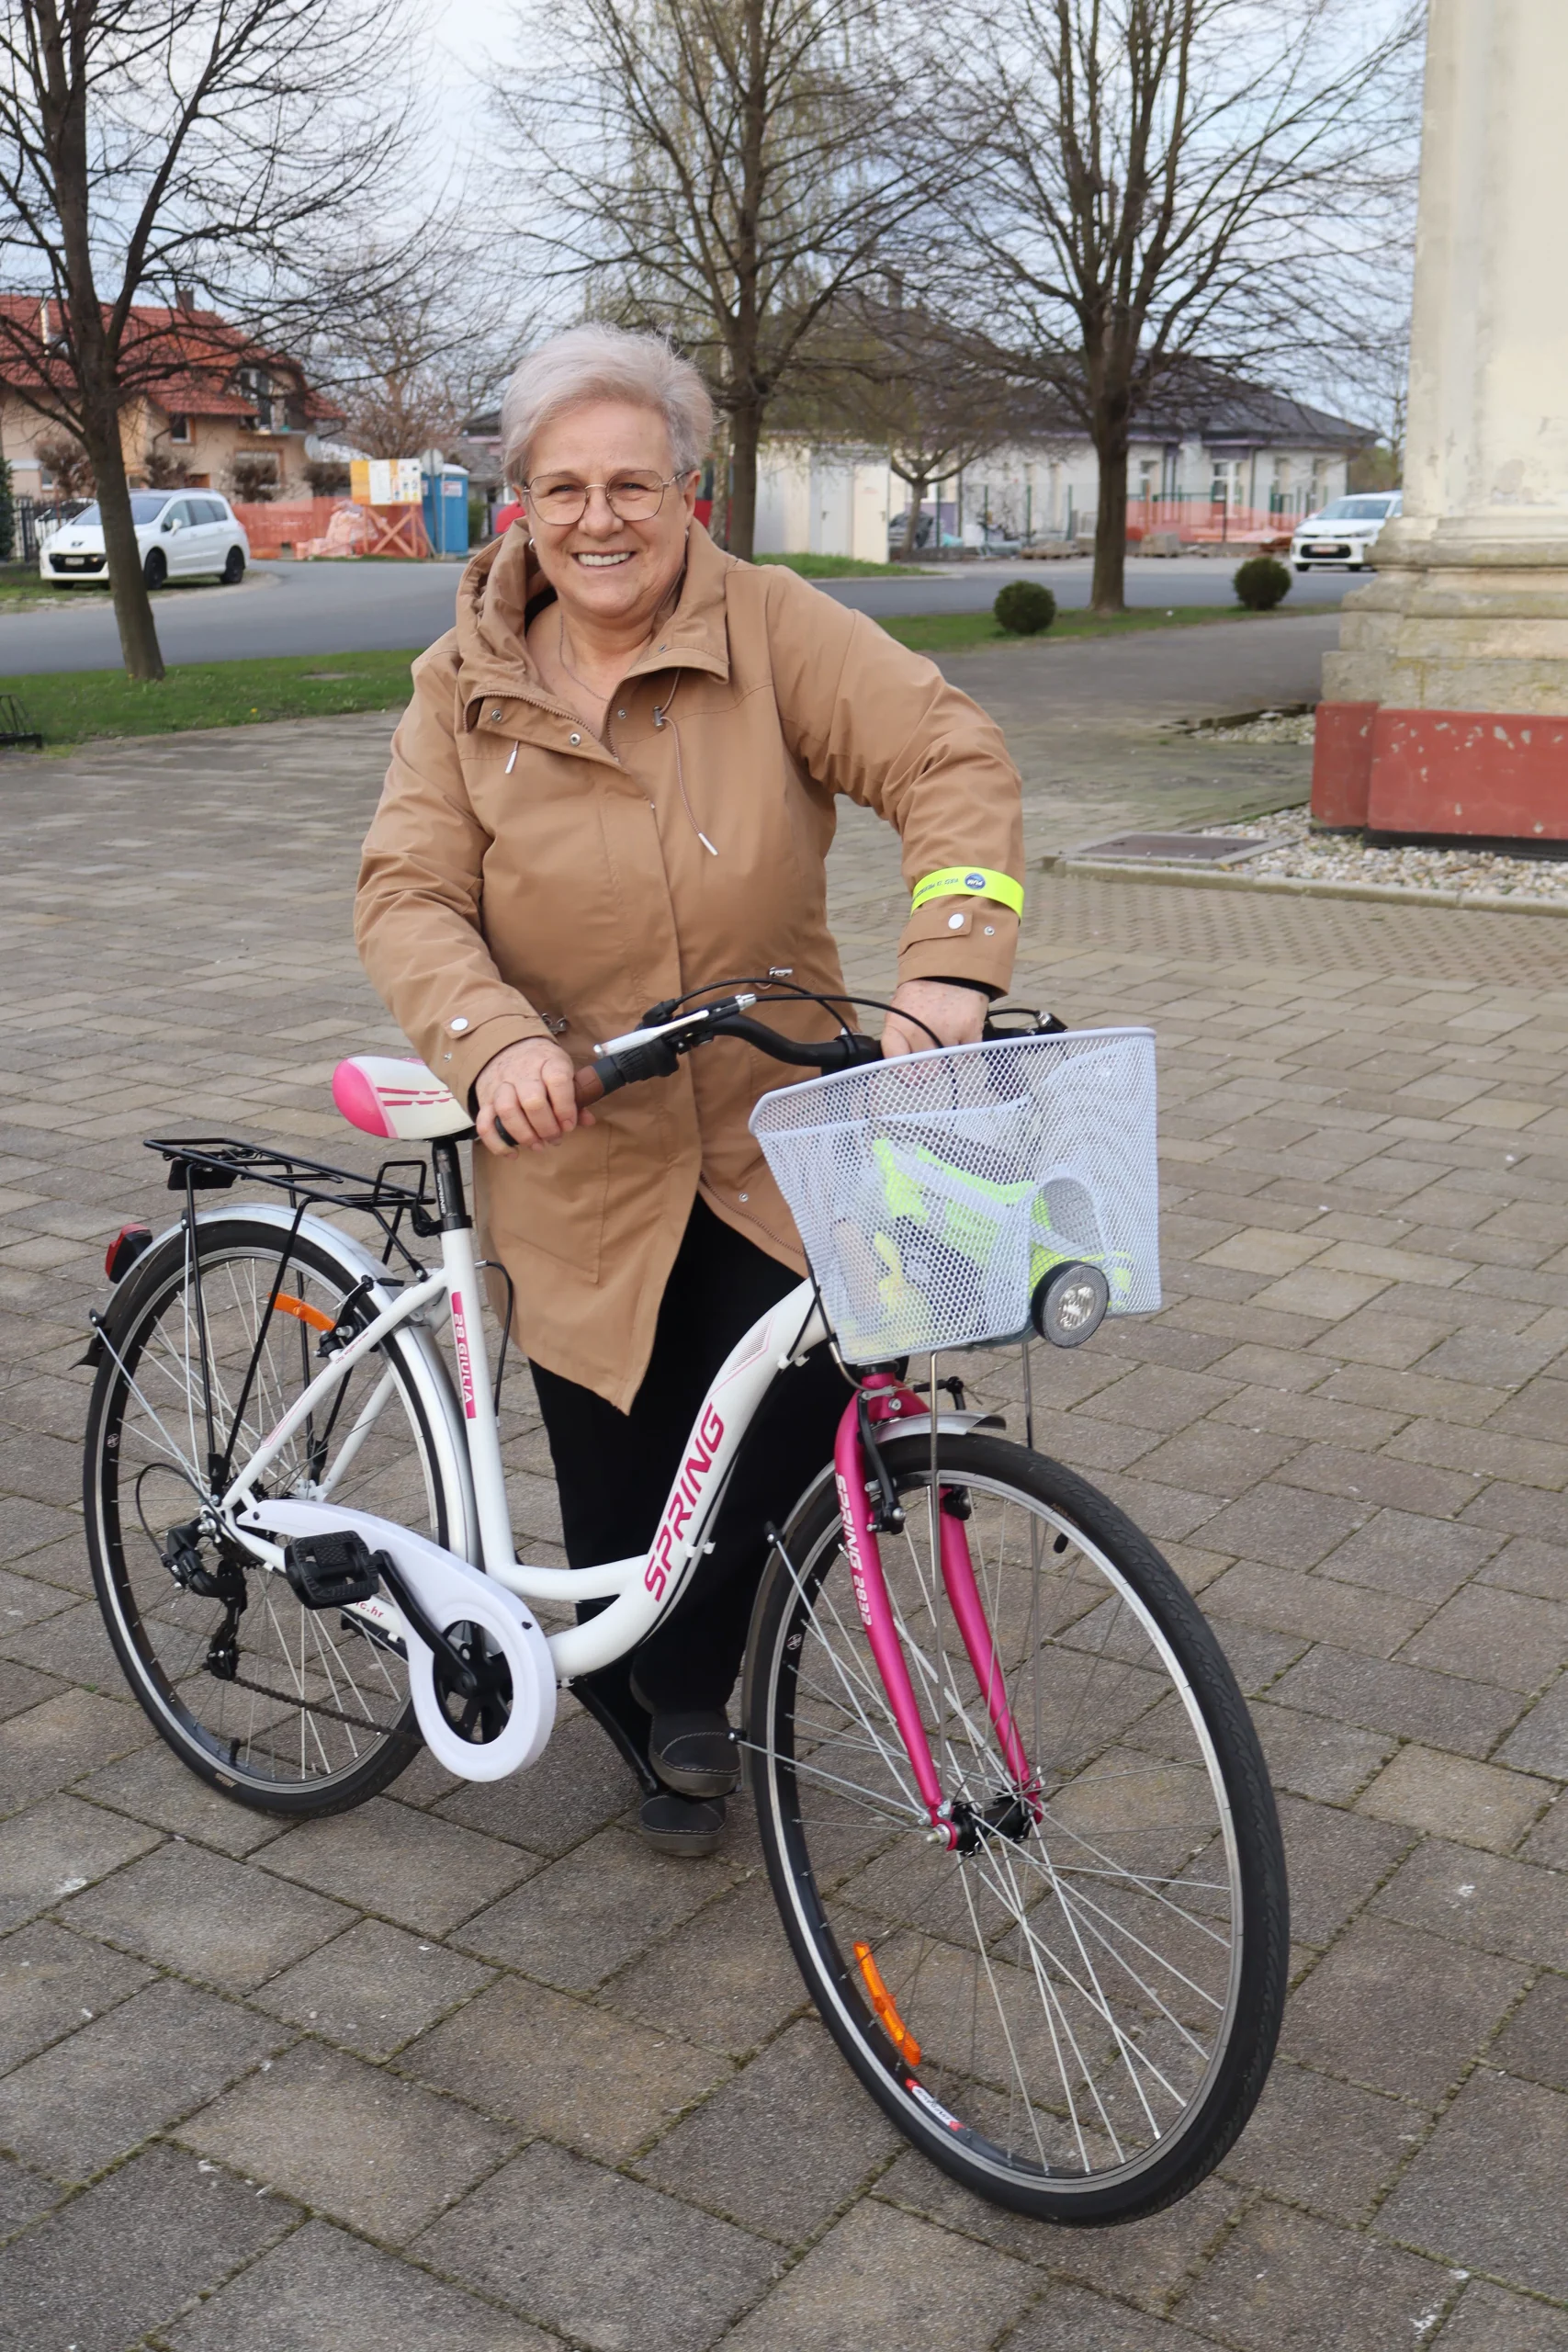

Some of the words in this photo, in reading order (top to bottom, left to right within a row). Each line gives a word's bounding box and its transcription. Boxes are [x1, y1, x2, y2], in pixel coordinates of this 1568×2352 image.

[454, 1313, 465, 1339] 28
[458, 1342, 473, 1403] GIULIA
[644, 1402, 725, 1602] SPRING
[835, 1473, 863, 1571] SPRING
[852, 1574, 872, 1625] 2832
